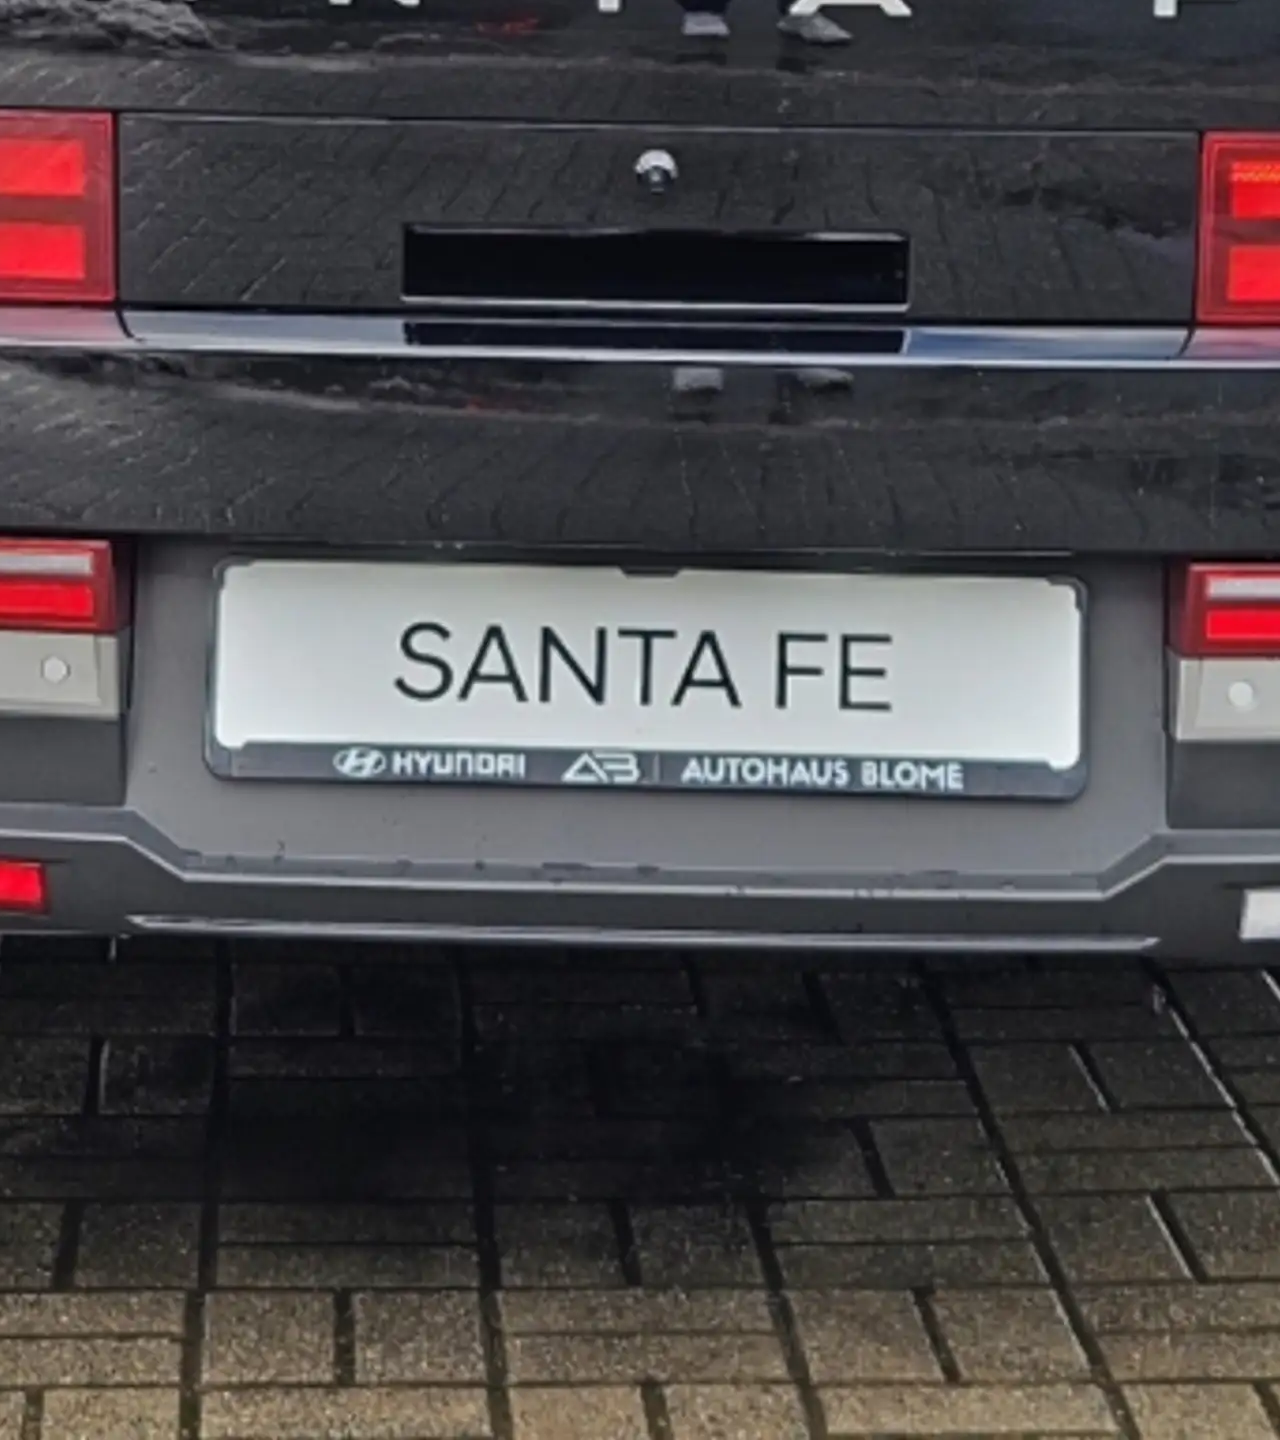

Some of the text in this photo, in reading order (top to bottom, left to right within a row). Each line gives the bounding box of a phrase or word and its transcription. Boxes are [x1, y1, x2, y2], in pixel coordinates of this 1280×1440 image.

[394, 620, 894, 712] SANTA FE
[391, 751, 526, 779] HYUNDAI
[680, 756, 849, 790] AUTOHAUS
[861, 761, 966, 792] BLOME
